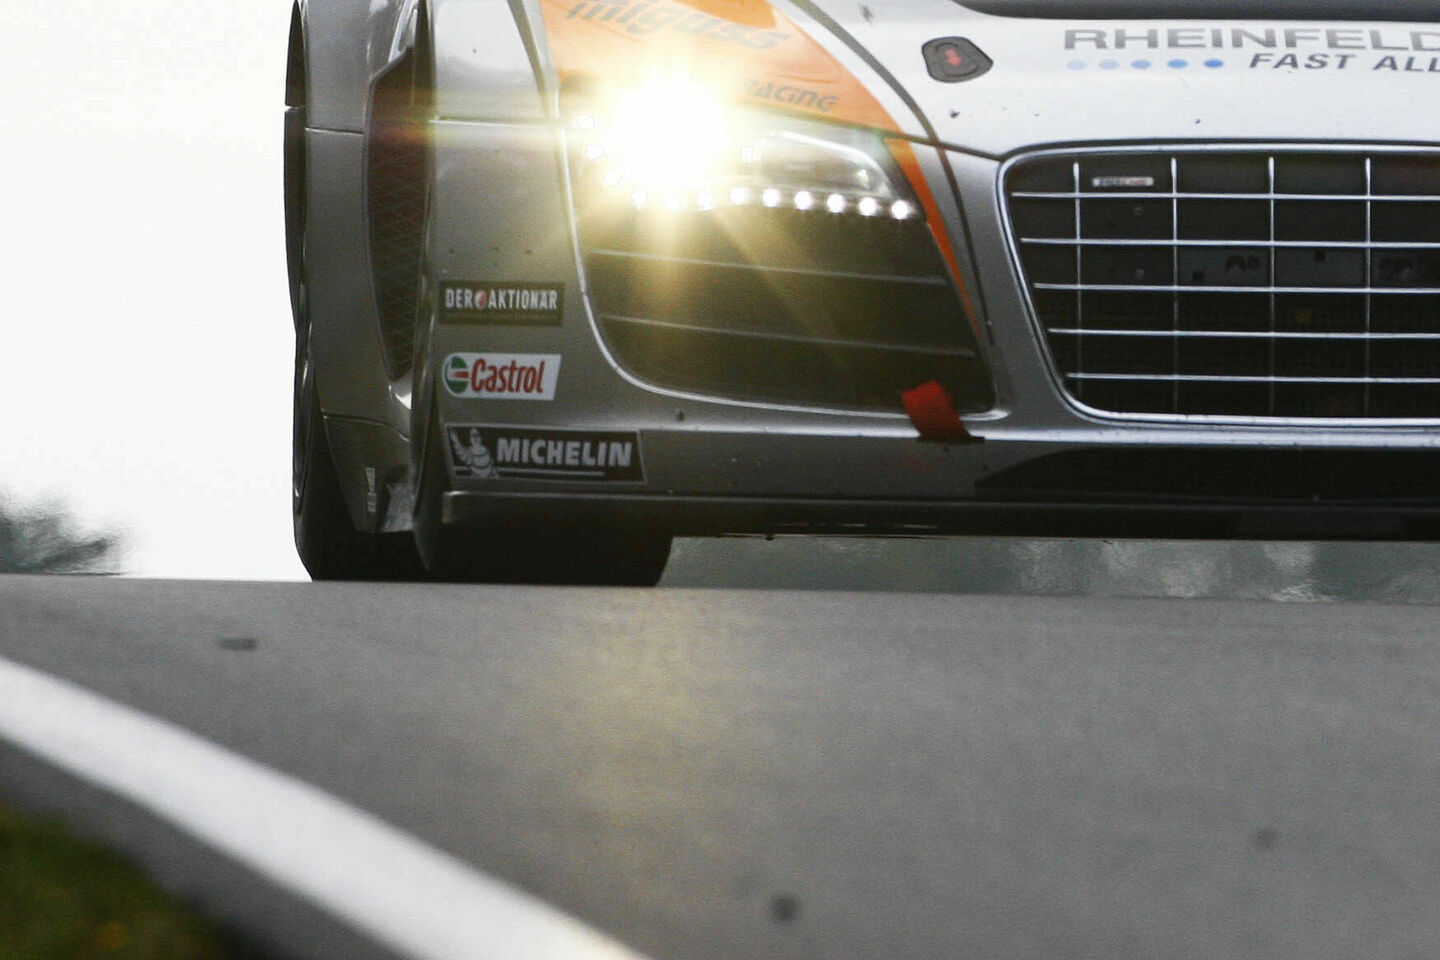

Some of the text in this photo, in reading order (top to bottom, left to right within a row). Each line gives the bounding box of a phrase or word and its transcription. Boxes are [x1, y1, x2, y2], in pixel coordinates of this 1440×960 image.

[1248, 53, 1357, 70] FAST
[445, 288, 473, 309] DER
[470, 358, 546, 394] Castrol
[496, 437, 633, 467] MICHELIN
